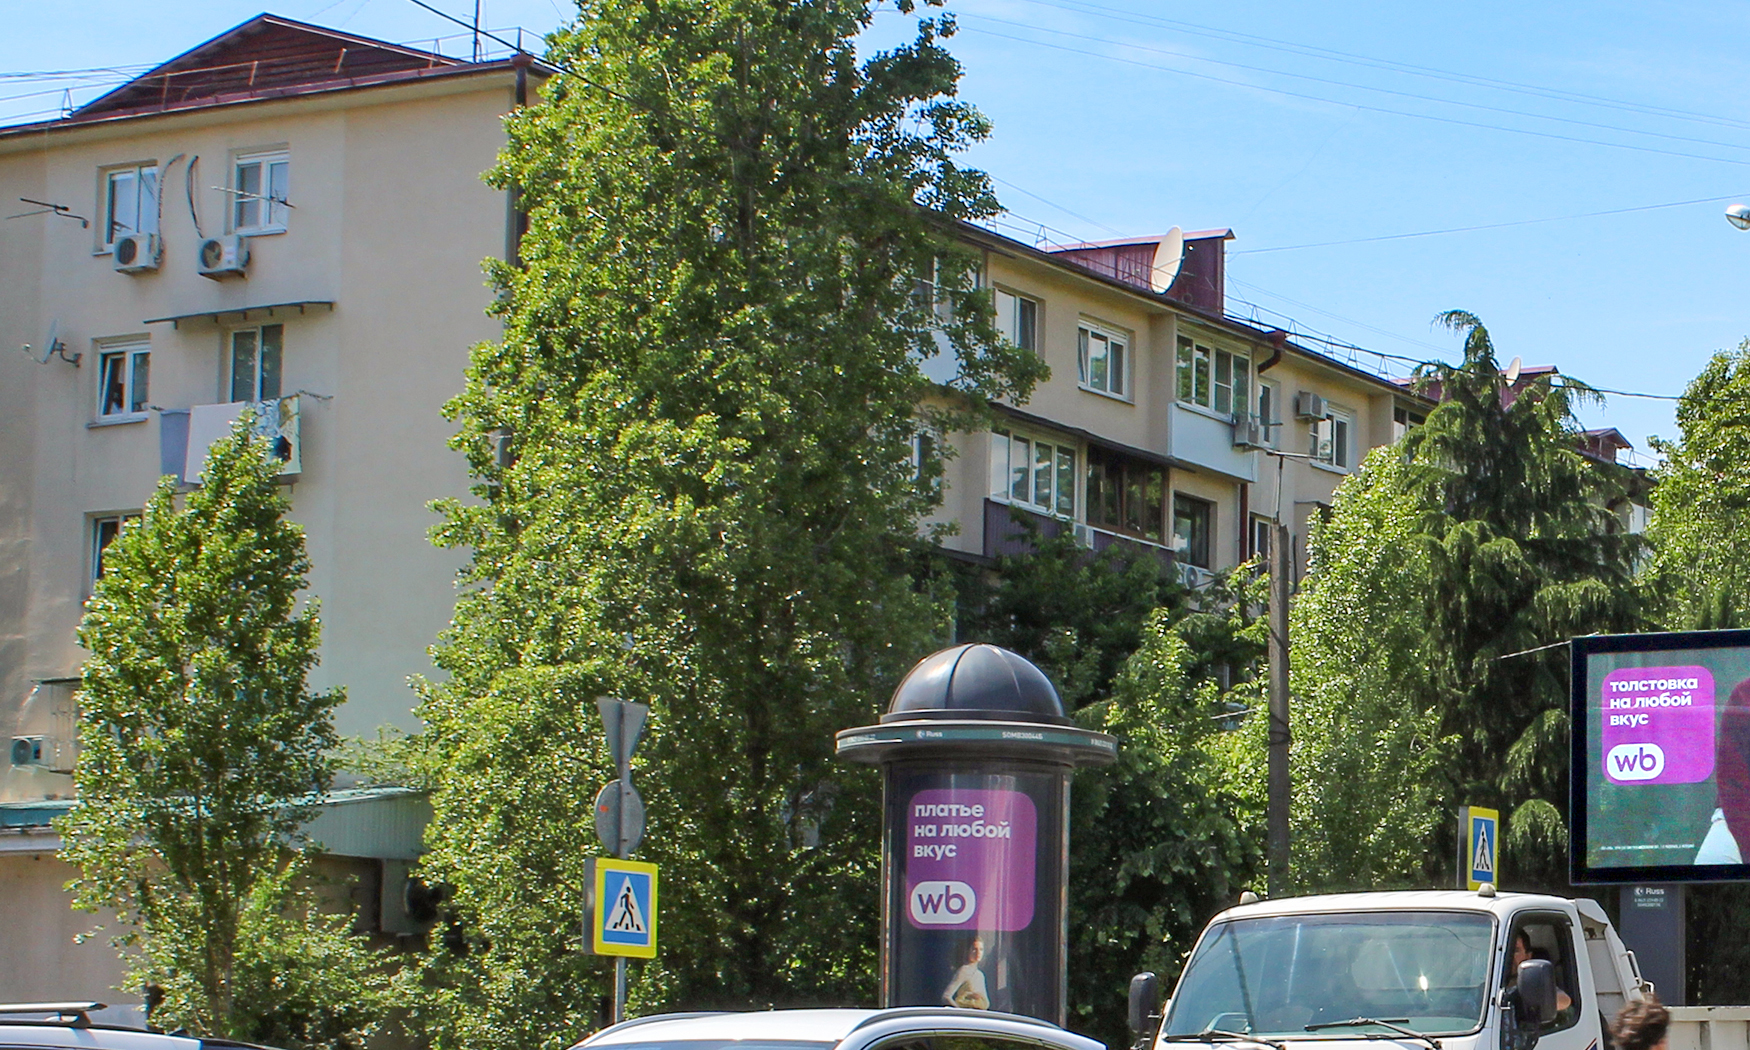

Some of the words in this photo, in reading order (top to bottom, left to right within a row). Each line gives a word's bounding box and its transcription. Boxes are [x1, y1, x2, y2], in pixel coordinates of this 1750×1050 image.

[1610, 678, 1698, 692] толстовка
[1610, 698, 1631, 709] на
[1634, 691, 1692, 708] любой
[1610, 714, 1649, 728] вкус
[1614, 747, 1656, 772] wb
[915, 804, 984, 817] платье
[914, 824, 937, 837] на
[940, 820, 1011, 838] любой
[914, 844, 957, 861] вкус
[917, 884, 966, 915] wb
